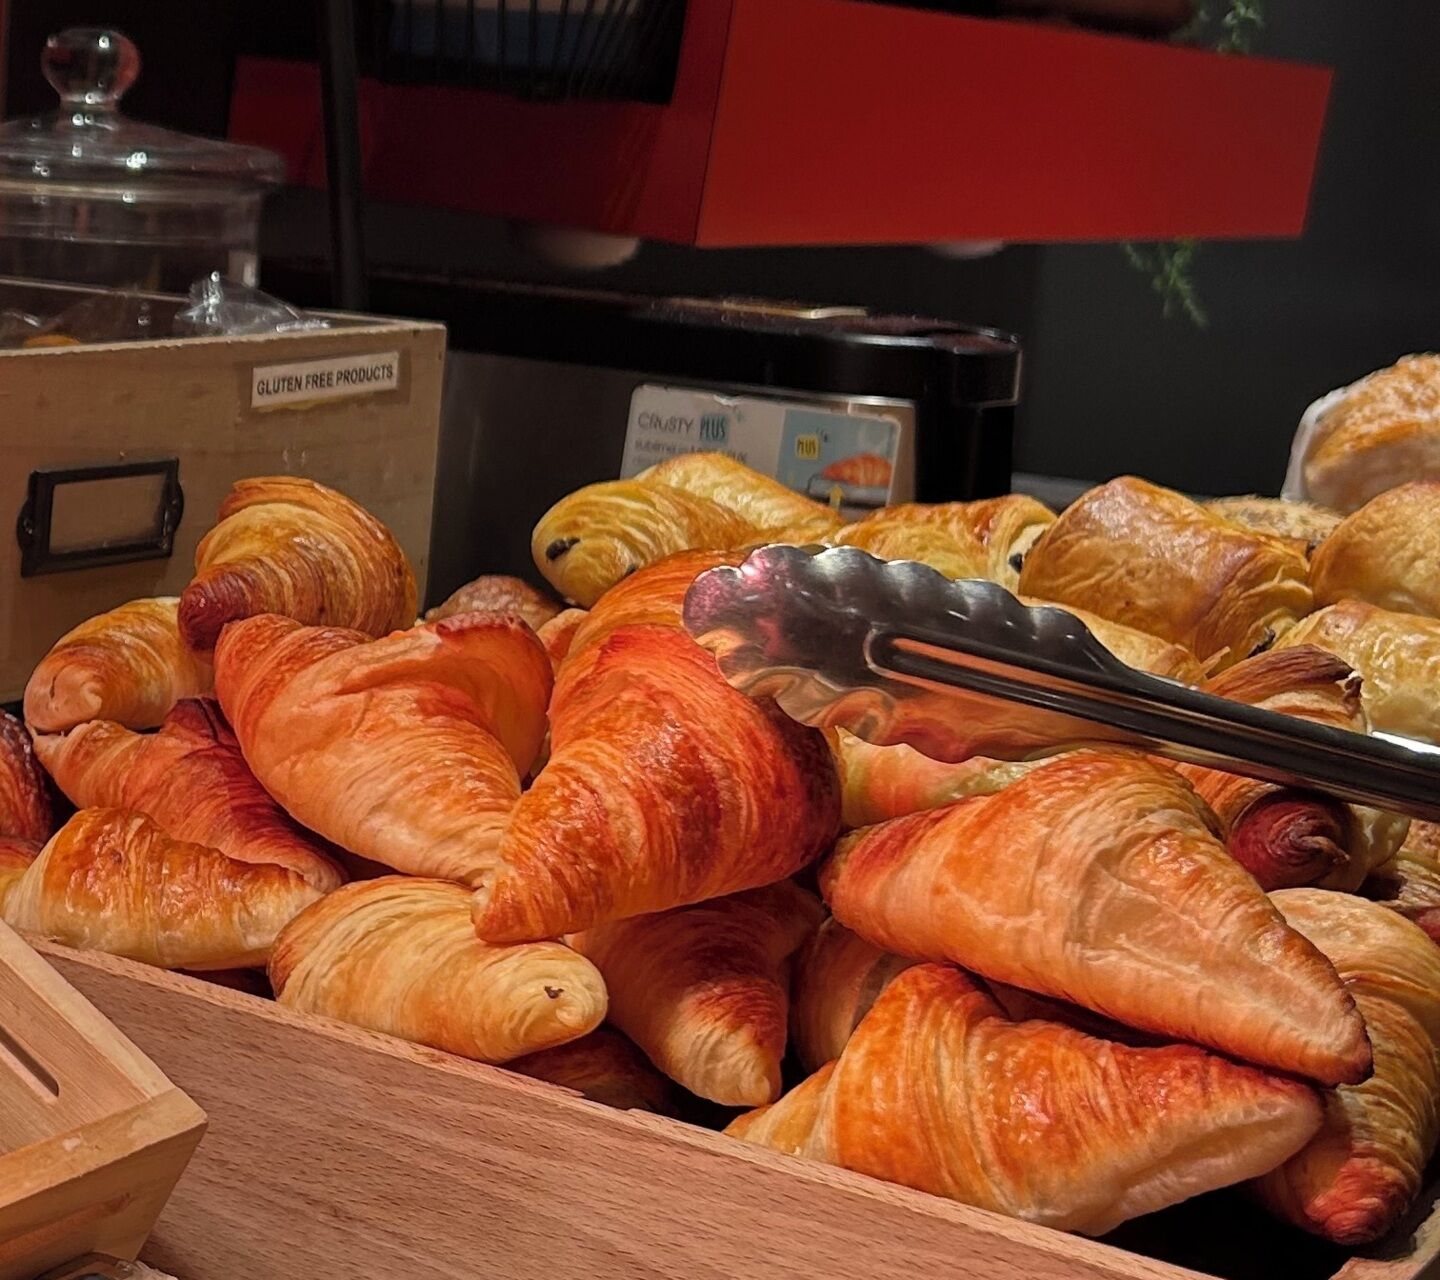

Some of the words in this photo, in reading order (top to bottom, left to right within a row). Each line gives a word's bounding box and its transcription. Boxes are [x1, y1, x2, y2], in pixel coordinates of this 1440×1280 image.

[256, 375, 302, 396] GLUTEN
[305, 370, 334, 389] FREE
[336, 363, 394, 386] PRODUCTS
[699, 414, 726, 441] PLUS
